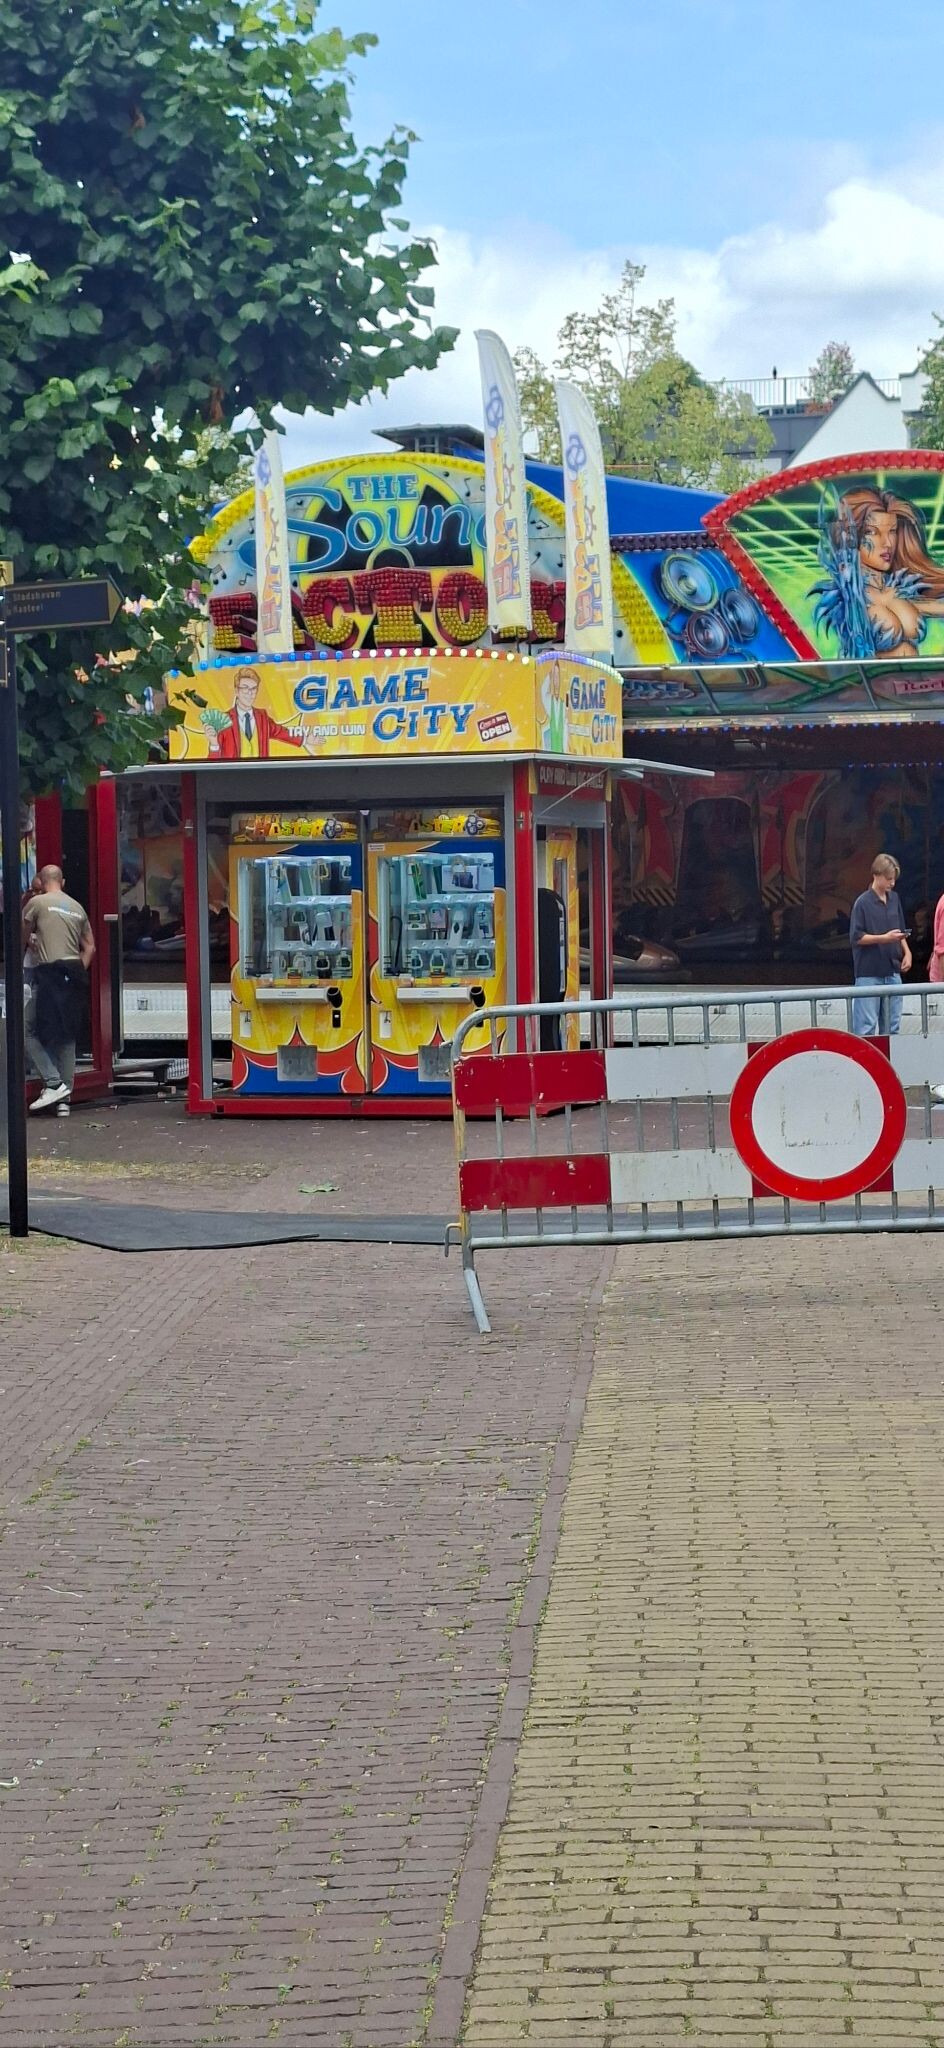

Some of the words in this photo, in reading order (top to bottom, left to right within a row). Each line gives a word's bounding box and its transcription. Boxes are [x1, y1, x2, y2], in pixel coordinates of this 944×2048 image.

[347, 474, 419, 501] THE
[293, 666, 430, 713] GAME
[570, 676, 606, 710] GAME
[288, 726, 309, 737] TRY
[313, 725, 339, 737] AND
[341, 724, 366, 736] WIN
[482, 724, 511, 740] OPEN
